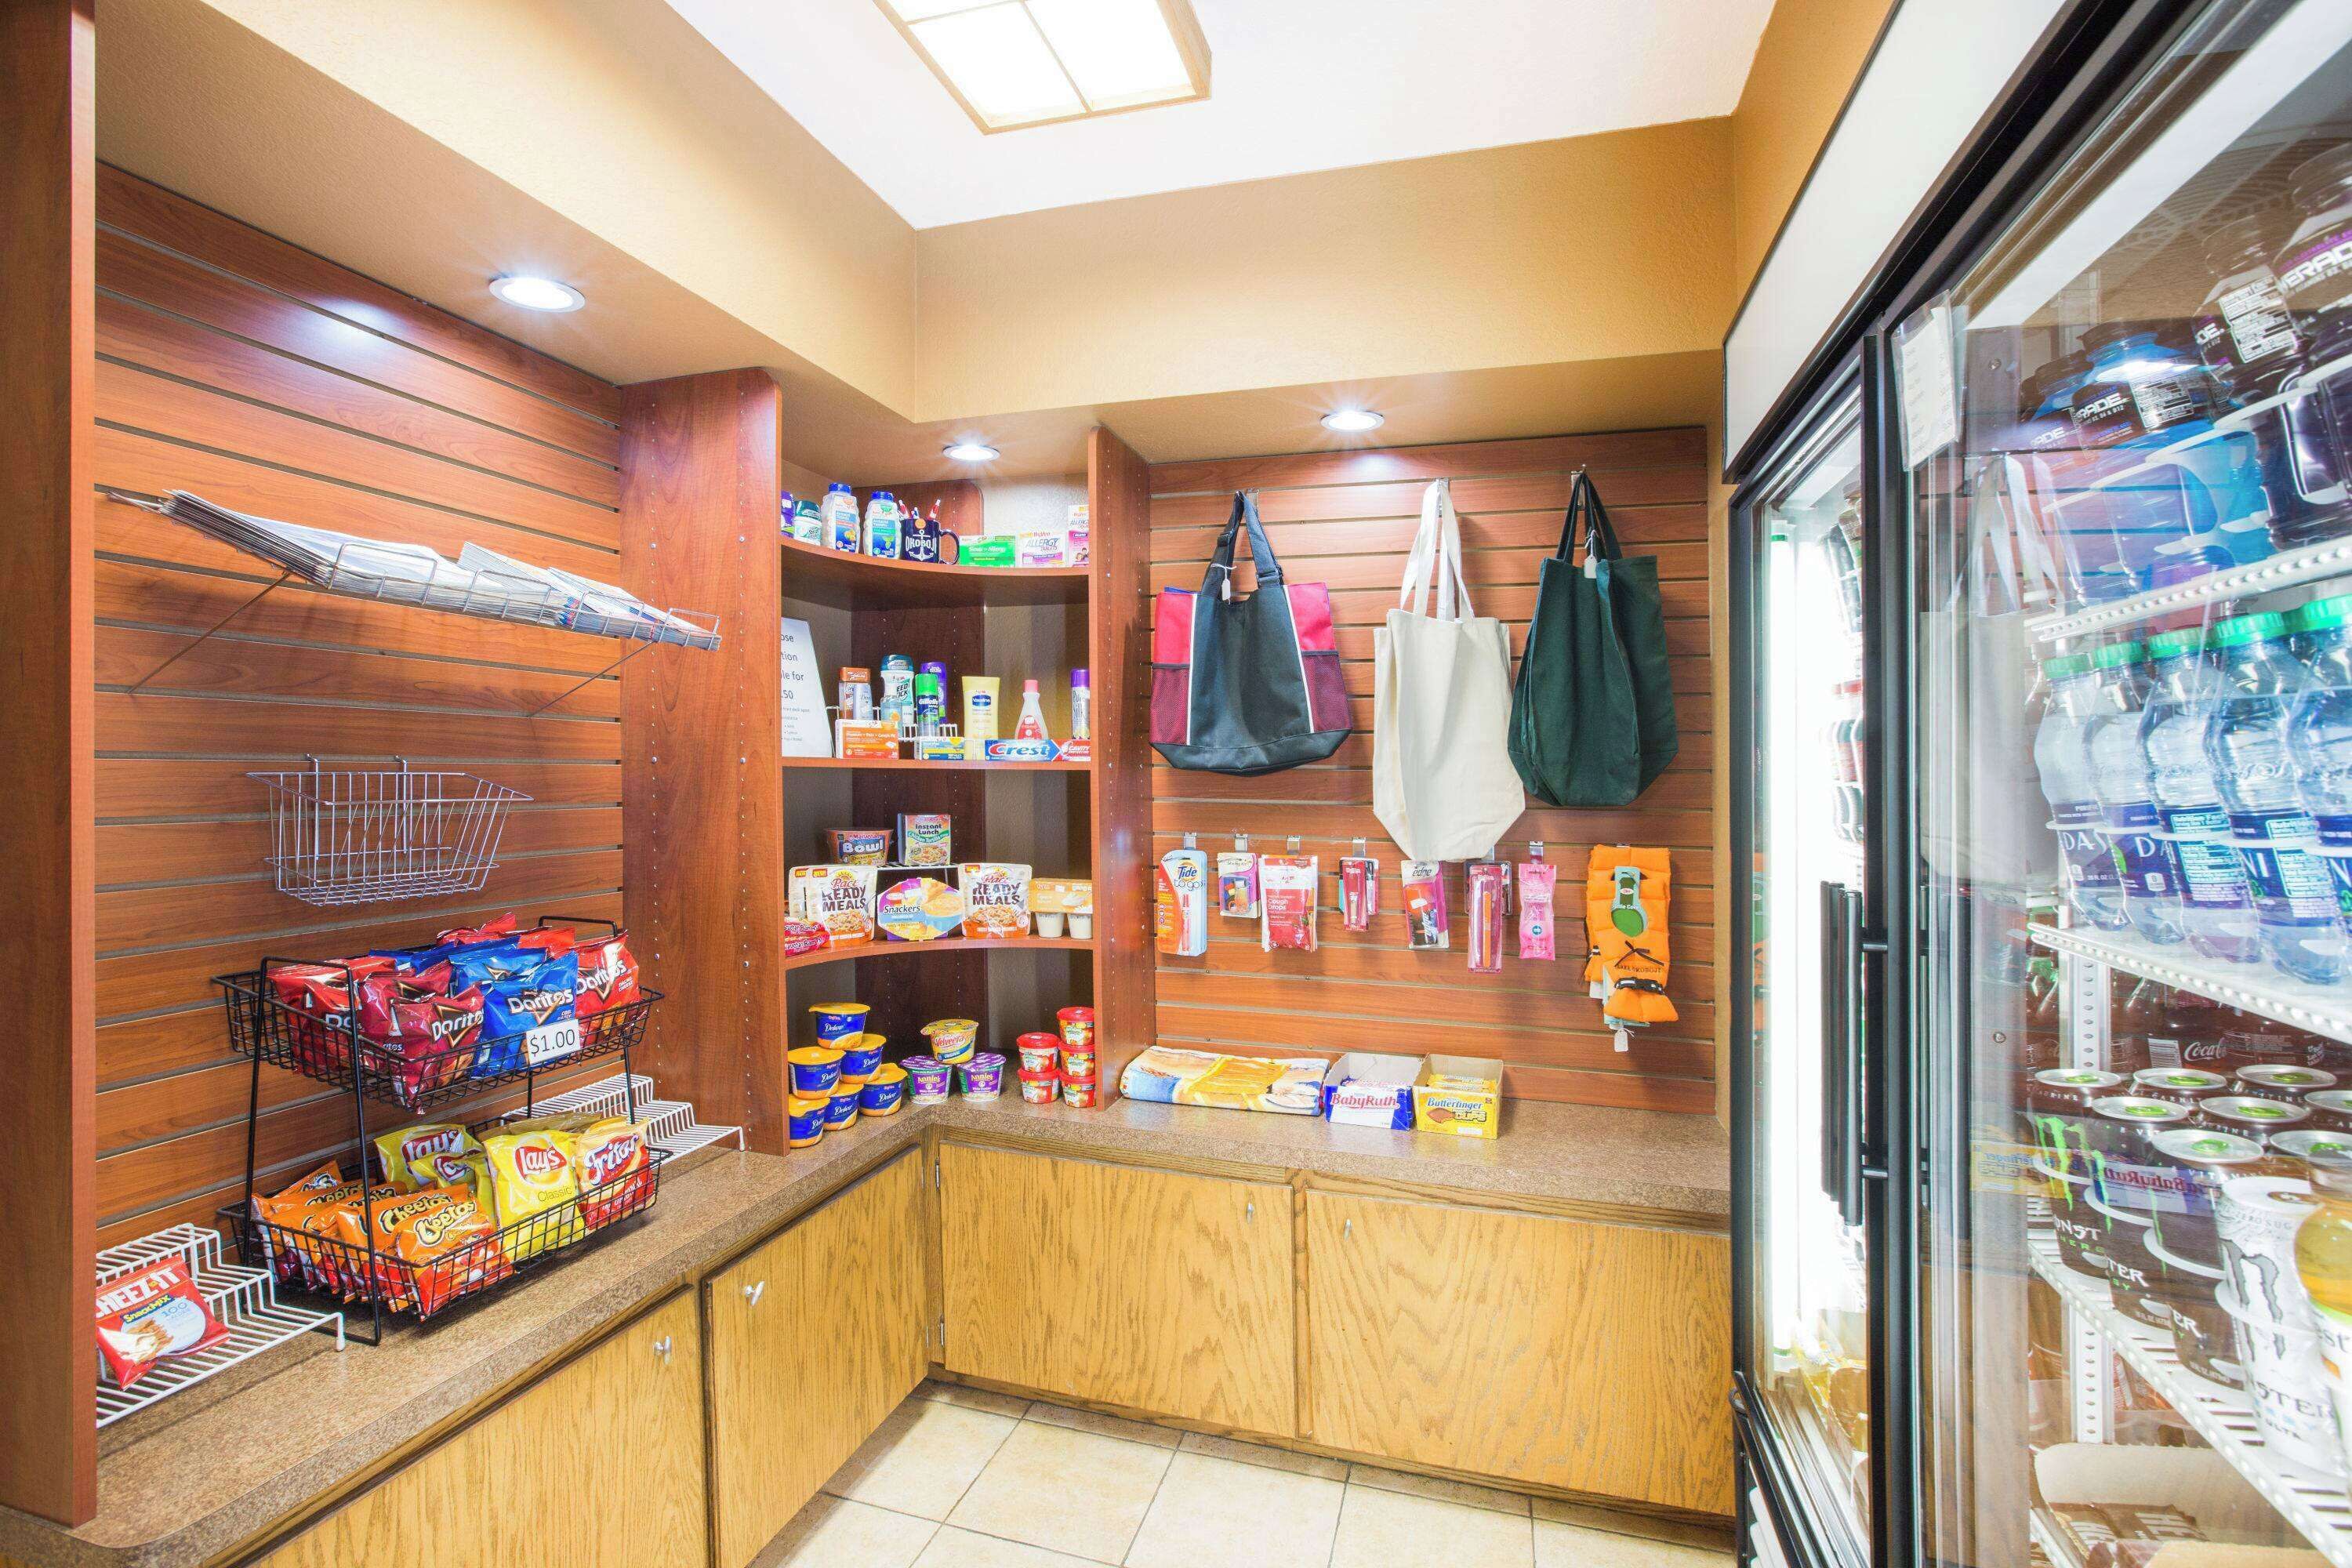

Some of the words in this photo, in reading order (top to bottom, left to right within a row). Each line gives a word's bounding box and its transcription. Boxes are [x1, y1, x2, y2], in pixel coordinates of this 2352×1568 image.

[905, 535, 937, 554] OKOBOJI
[1025, 538, 1059, 547] ALLERGY
[792, 670, 804, 681] for
[989, 743, 1049, 757] Crest
[843, 839, 884, 853] Bowl
[1178, 866, 1197, 879] Tide
[1174, 879, 1185, 887] to
[1187, 880, 1200, 891] go
[822, 898, 866, 912] MEALS
[973, 895, 1020, 906] MEALS
[884, 905, 920, 913] Snackers
[576, 960, 627, 996] Doritos
[508, 989, 575, 1014] Doritos
[529, 1028, 576, 1056] $1.00
[918, 1075, 940, 1083] Annie's
[1428, 1097, 1483, 1110] Butterfinger
[521, 1149, 562, 1176] Lay's
[585, 1134, 640, 1185] Fritos
[537, 1185, 573, 1203] Classic
[379, 1194, 452, 1234] Cheetos
[414, 1201, 477, 1247] Cheetos
[161, 1302, 187, 1317] 100
